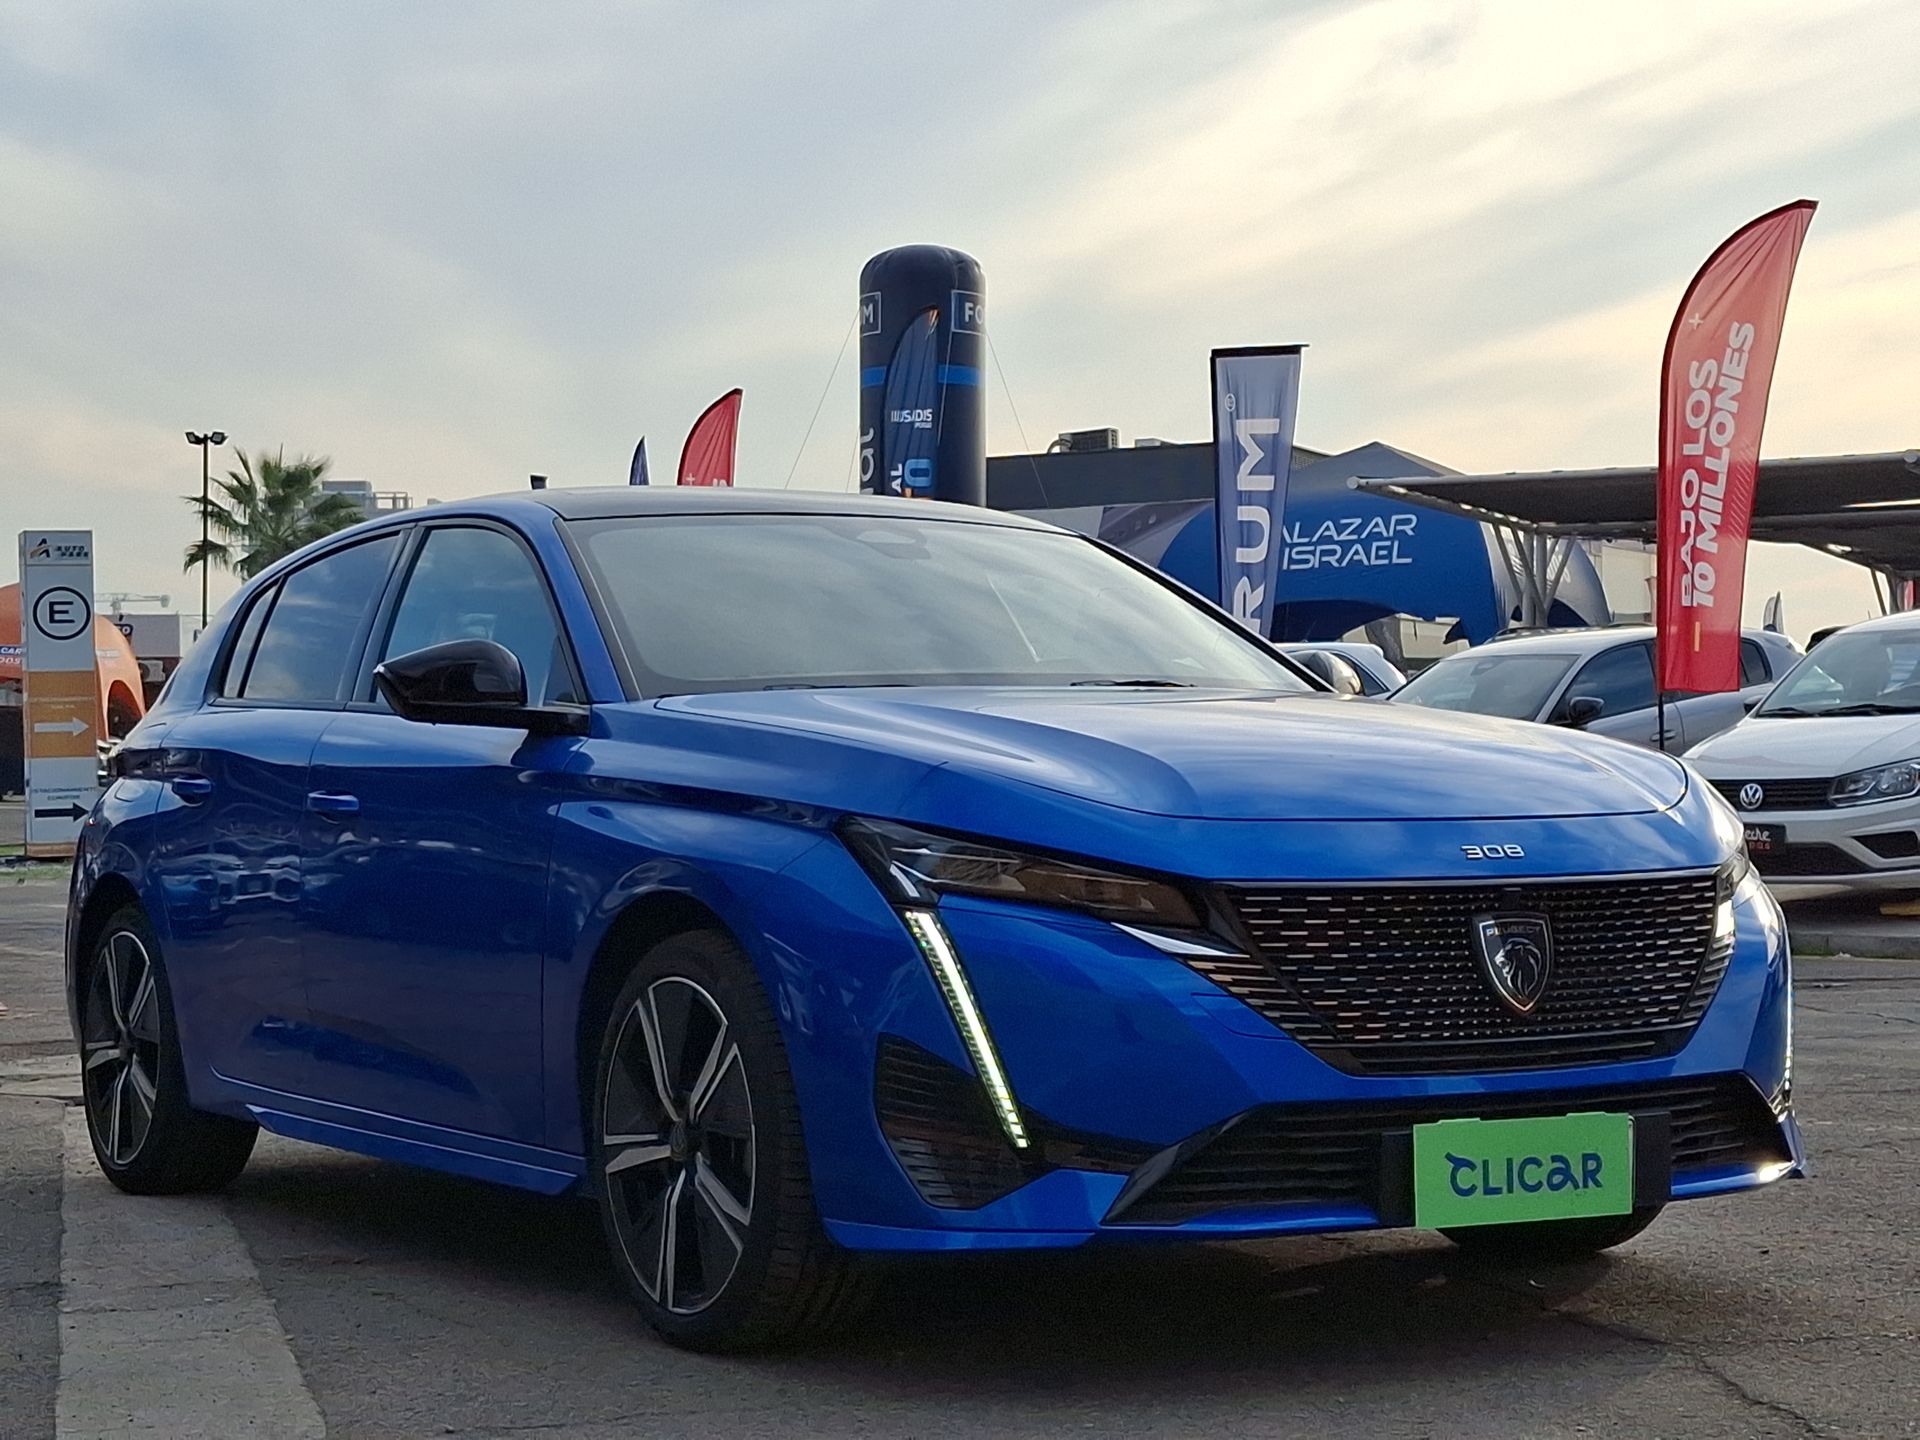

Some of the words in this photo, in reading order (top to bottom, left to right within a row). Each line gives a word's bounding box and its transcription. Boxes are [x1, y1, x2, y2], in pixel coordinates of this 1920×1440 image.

[1682, 358, 1718, 456] LOS
[1695, 321, 1755, 553] MILLONES
[1282, 540, 1413, 570] ISRAEL
[1681, 468, 1700, 607] BAJO
[1692, 561, 1717, 608] 10
[48, 600, 76, 624] E
[1461, 844, 1525, 858] 308
